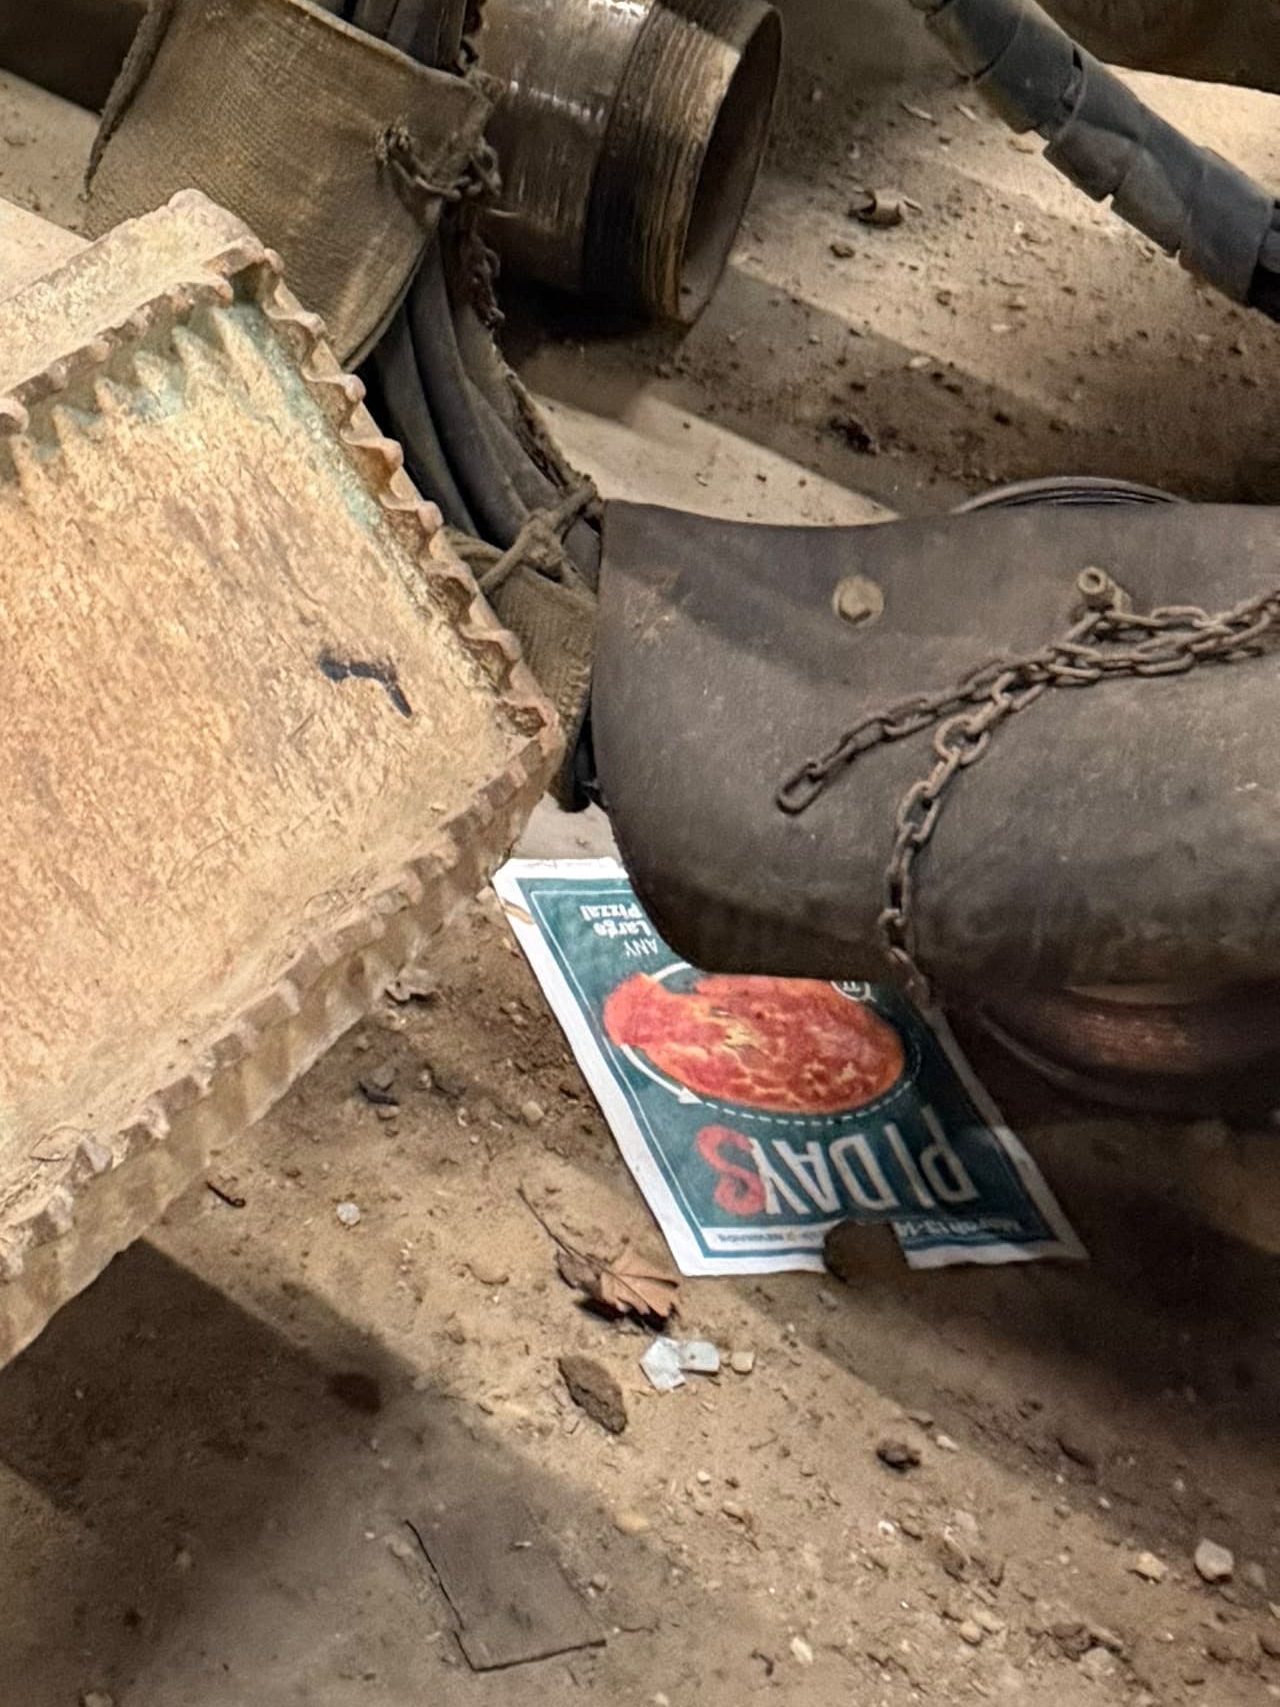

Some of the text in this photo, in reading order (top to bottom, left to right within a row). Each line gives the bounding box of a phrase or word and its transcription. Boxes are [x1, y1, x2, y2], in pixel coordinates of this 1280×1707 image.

[579, 902, 643, 922] Pizza!
[593, 918, 652, 939] Large
[623, 938, 659, 959] ANY
[695, 1105, 980, 1217] PI DAYS
